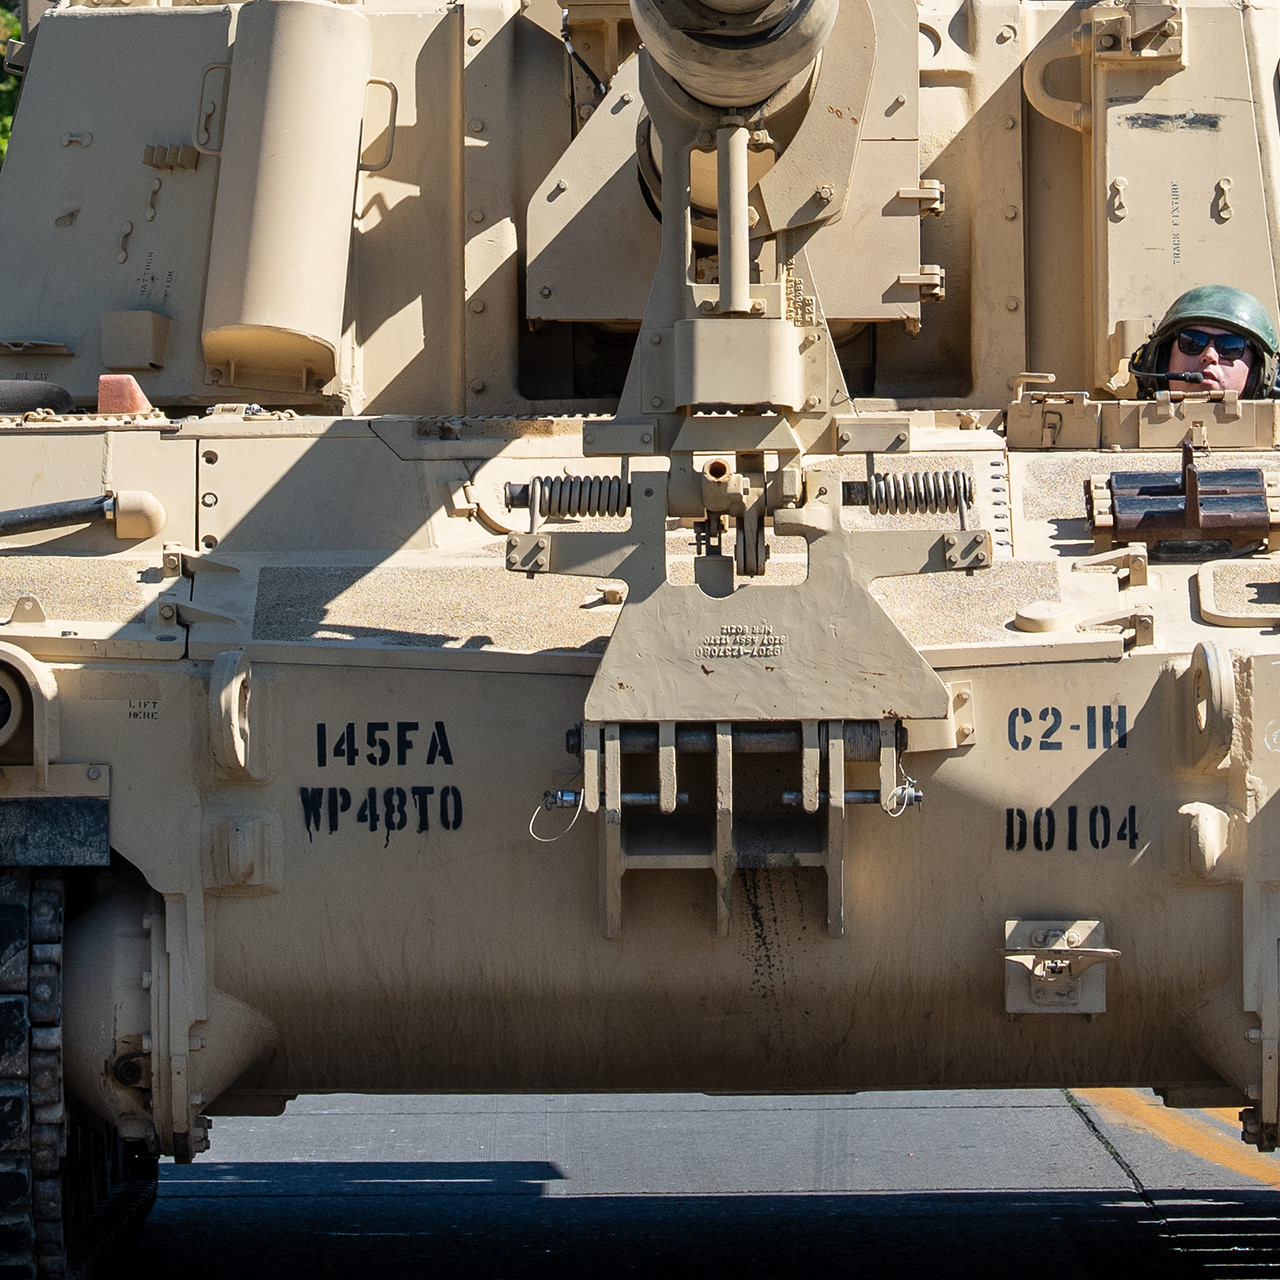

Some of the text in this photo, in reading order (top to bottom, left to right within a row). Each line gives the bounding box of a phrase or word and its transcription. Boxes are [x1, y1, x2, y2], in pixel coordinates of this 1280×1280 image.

[1170, 180, 1181, 266] TRACK FIXTURE
[140, 251, 154, 297] MATTOCK
[128, 700, 158, 709] LIFT
[128, 711, 158, 720] HERE
[316, 721, 454, 768] 145FA
